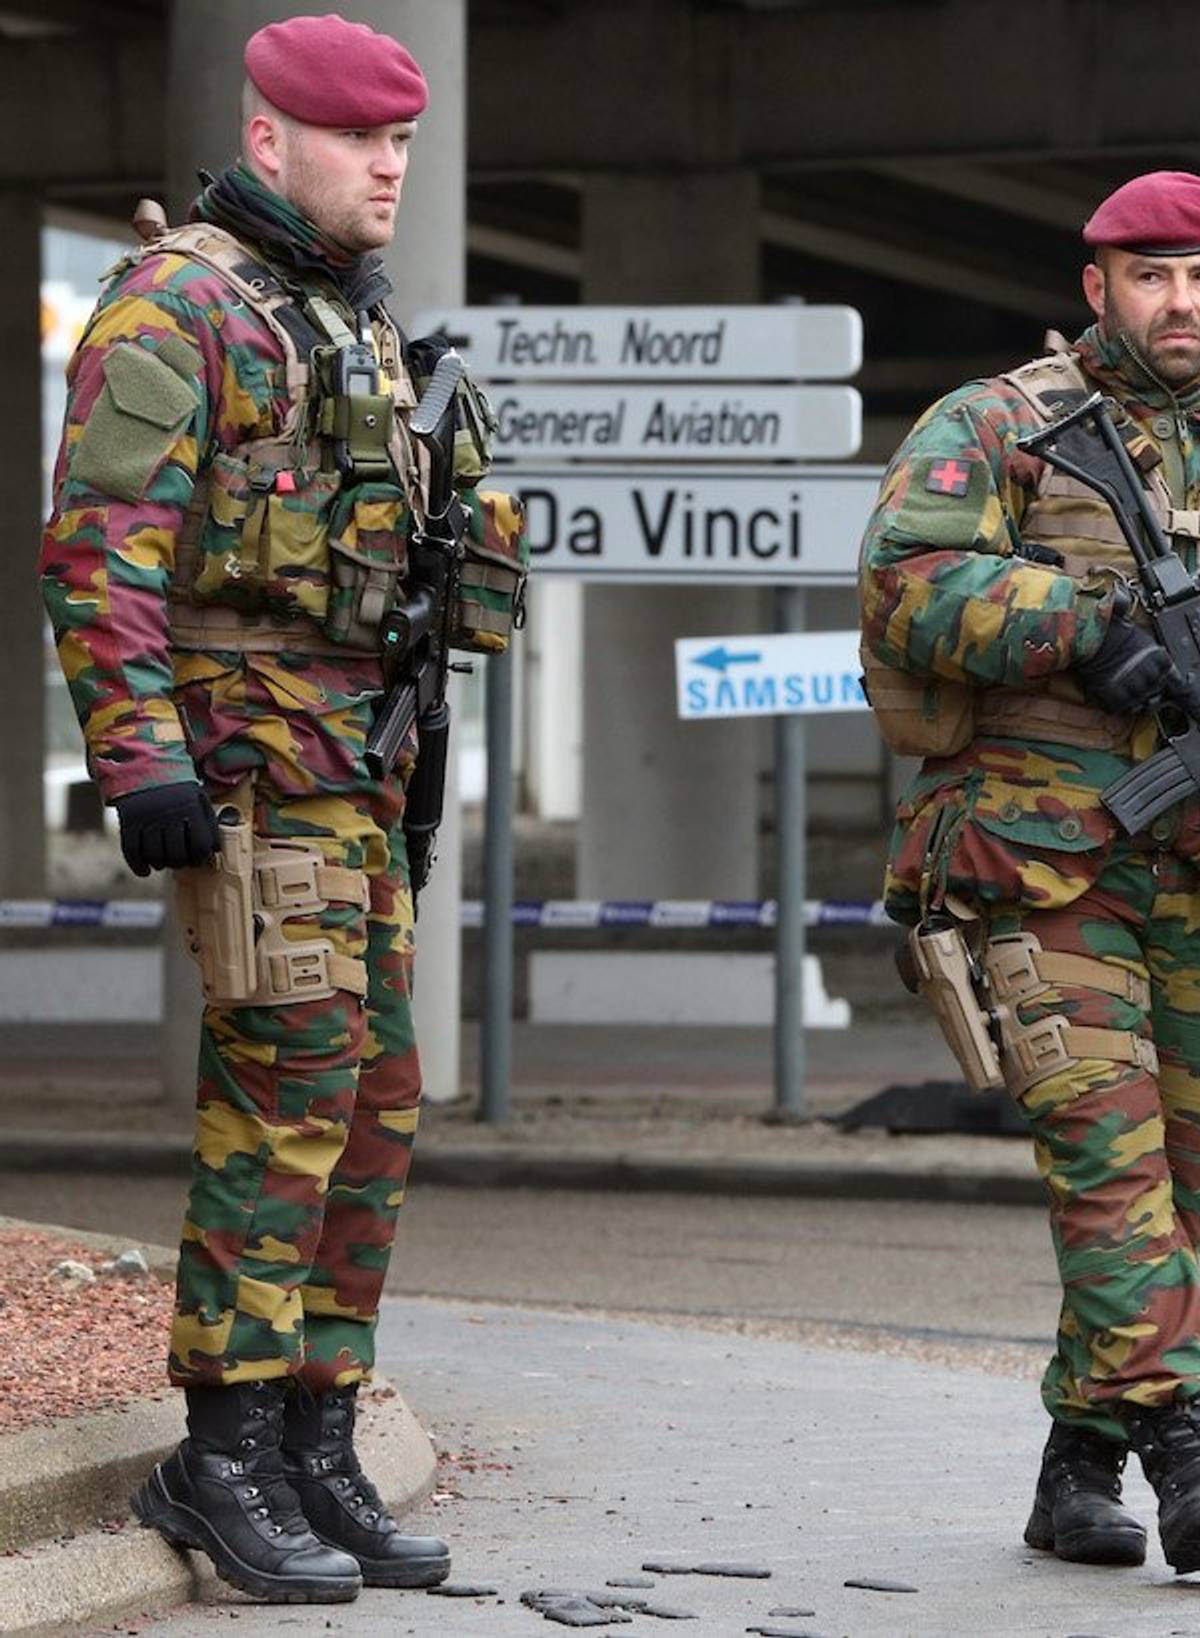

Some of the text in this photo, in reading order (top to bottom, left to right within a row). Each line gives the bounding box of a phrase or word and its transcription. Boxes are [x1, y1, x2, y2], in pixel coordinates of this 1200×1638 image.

[496, 318, 726, 366] Techn. Noord
[498, 398, 781, 446] General Aviation
[518, 487, 802, 560] Da Vinci
